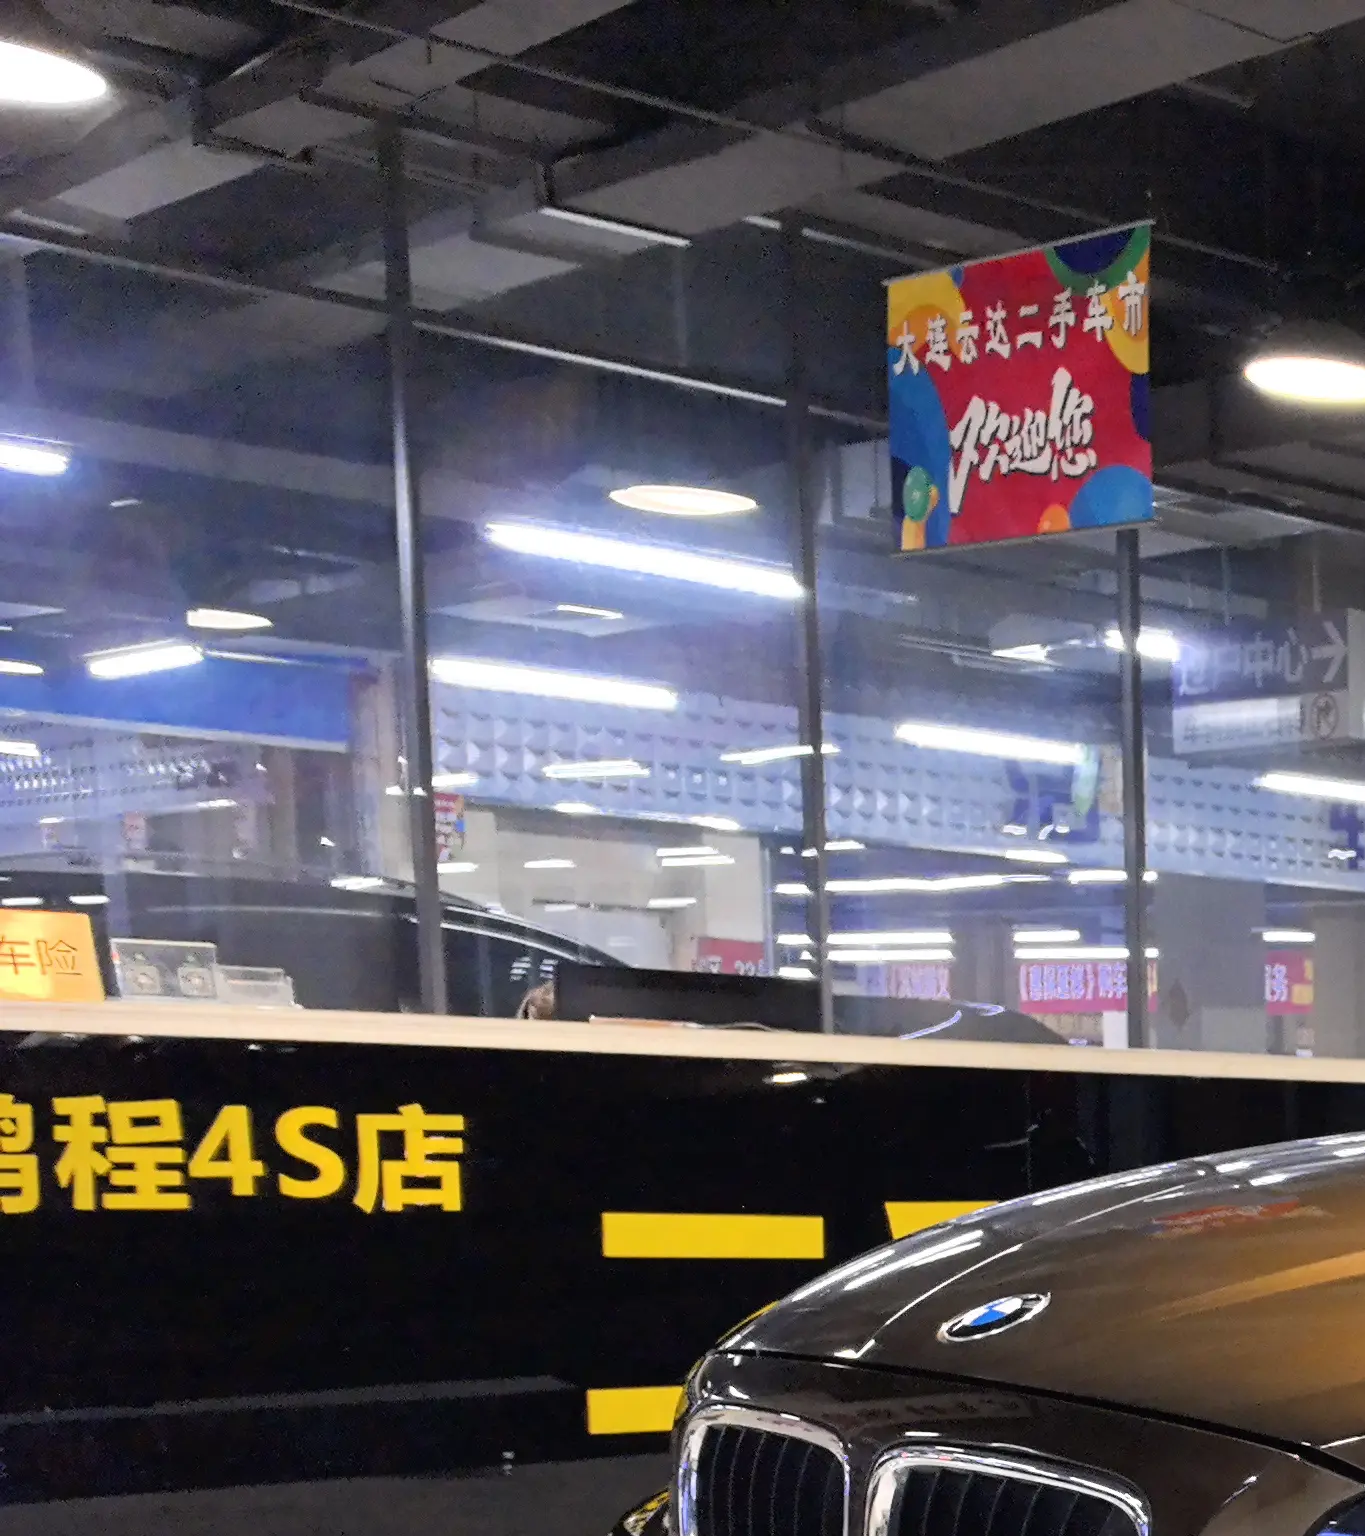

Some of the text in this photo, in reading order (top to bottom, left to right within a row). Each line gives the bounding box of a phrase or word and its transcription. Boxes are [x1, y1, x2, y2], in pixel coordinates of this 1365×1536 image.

[893, 271, 1147, 375] 大连云达二手车市
[948, 367, 1098, 514] 欢迎您
